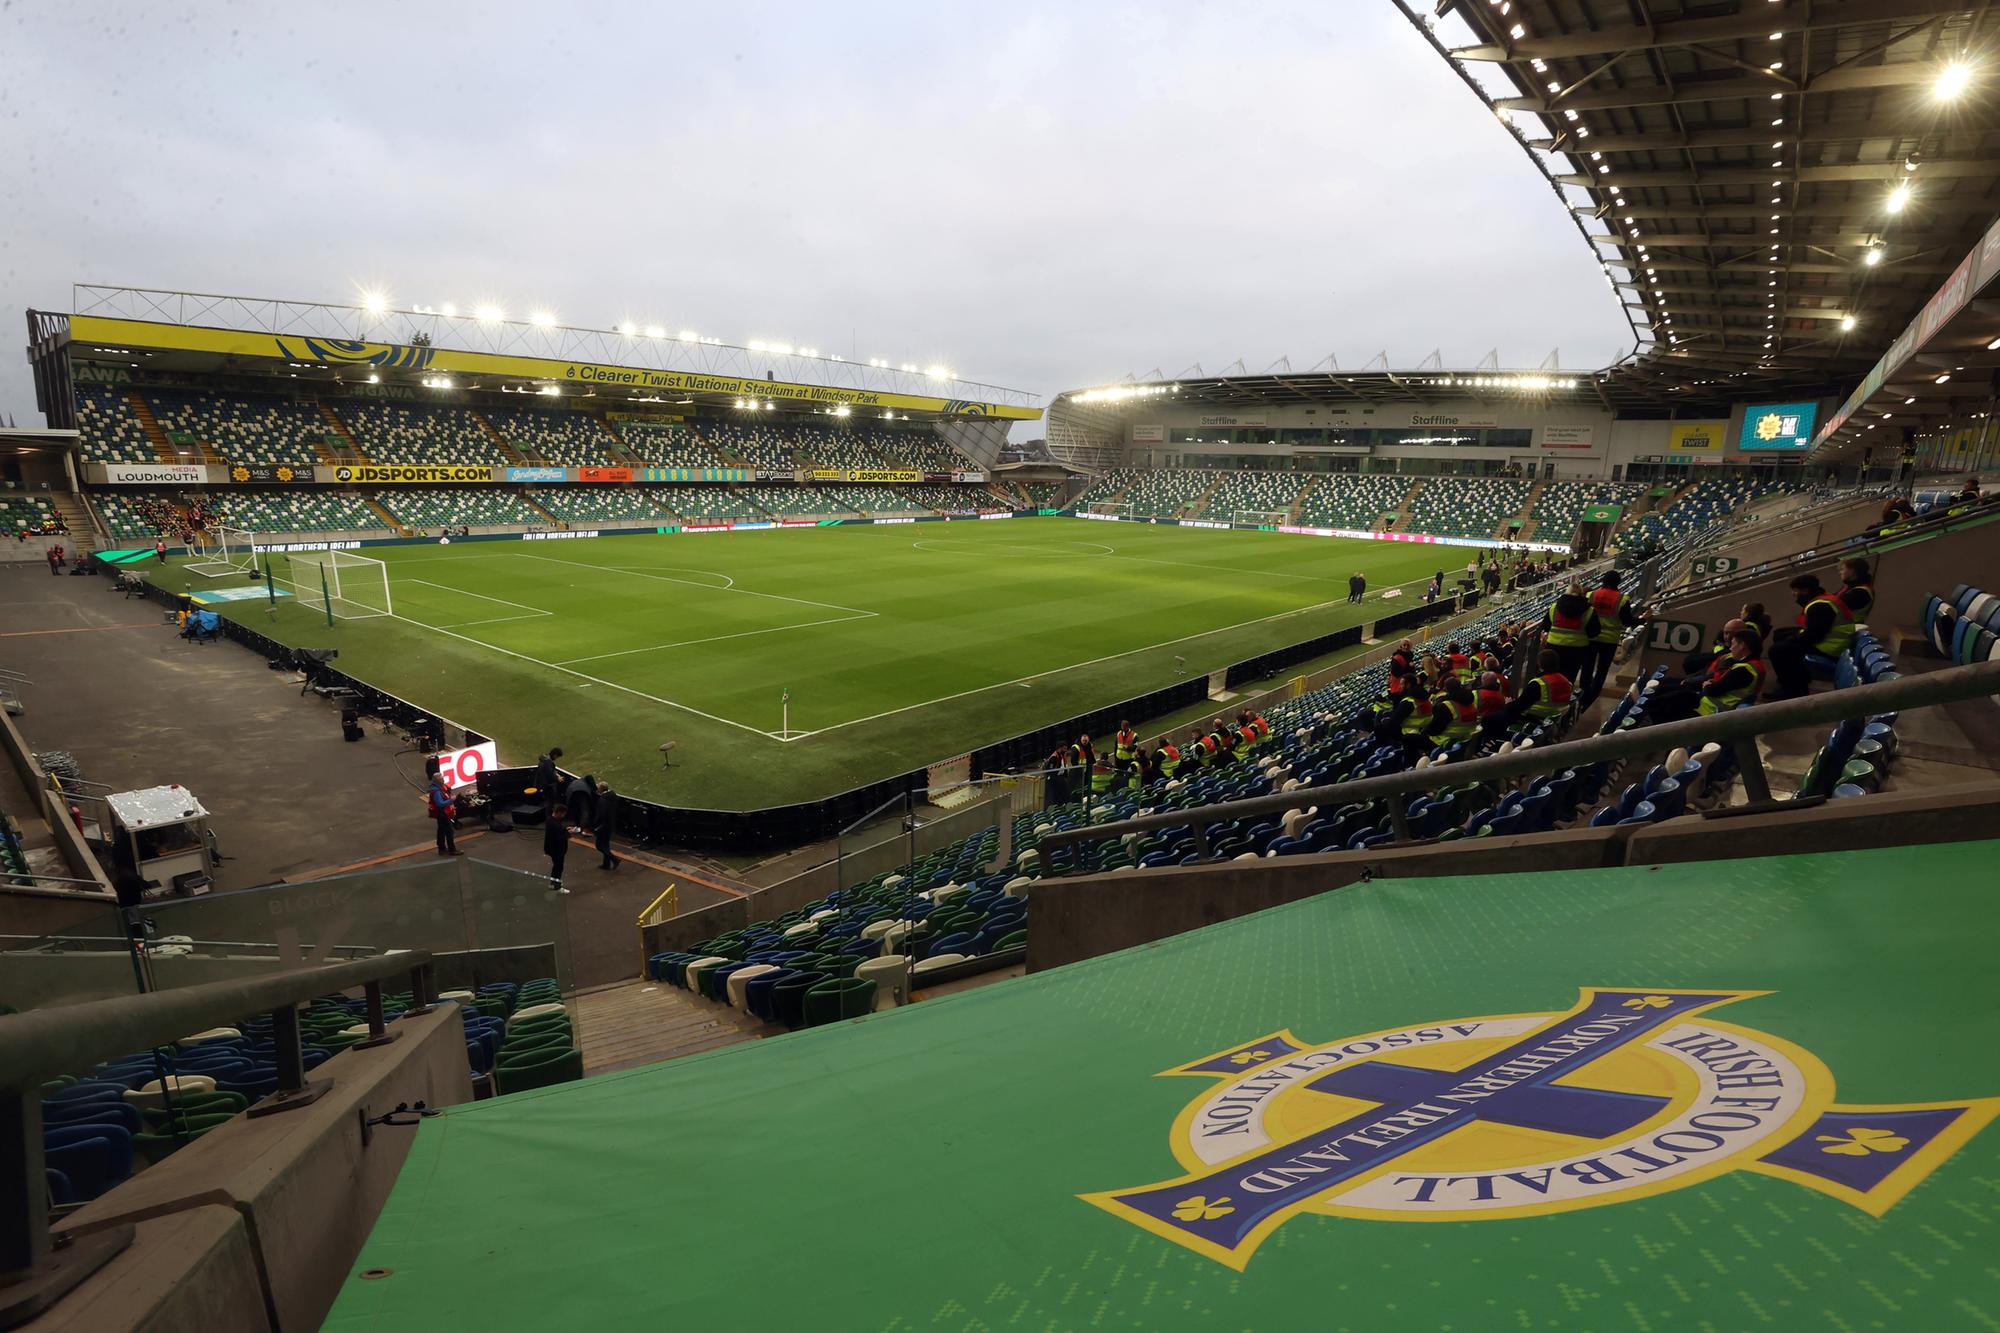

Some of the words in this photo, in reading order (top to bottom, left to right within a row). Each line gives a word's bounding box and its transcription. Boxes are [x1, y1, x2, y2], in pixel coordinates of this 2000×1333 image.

[72, 366, 132, 383] AWA
[580, 366, 639, 384] Clearer
[641, 372, 682, 386] Twist
[684, 375, 741, 392] National
[744, 381, 793, 396] Stadium
[797, 387, 809, 398] at
[811, 388, 855, 402] Windsor
[856, 392, 880, 404] Park
[1201, 416, 1237, 425] Staffline
[1412, 415, 1458, 425] Staffline
[1684, 439, 1708, 447] TWIST
[117, 473, 199, 481] LOUDMOUTH
[338, 470, 351, 479] JD
[355, 468, 492, 481] JDSPORTS.COM
[858, 472, 916, 480] JDSPORTS.COM
[287, 543, 328, 552] NORTHERN
[330, 541, 361, 550] IRELAND
[1695, 563, 1705, 573] 8
[1715, 558, 1731, 573] 9
[1650, 621, 1700, 652] 10
[1436, 1013, 1645, 1104] NORTHERN
[1661, 1032, 1784, 1090] IRISH
[1201, 1022, 1485, 1138] ASSOCIATION
[1239, 1102, 1462, 1193] IRELAND
[1393, 1095, 1782, 1202] FOOTBALL
